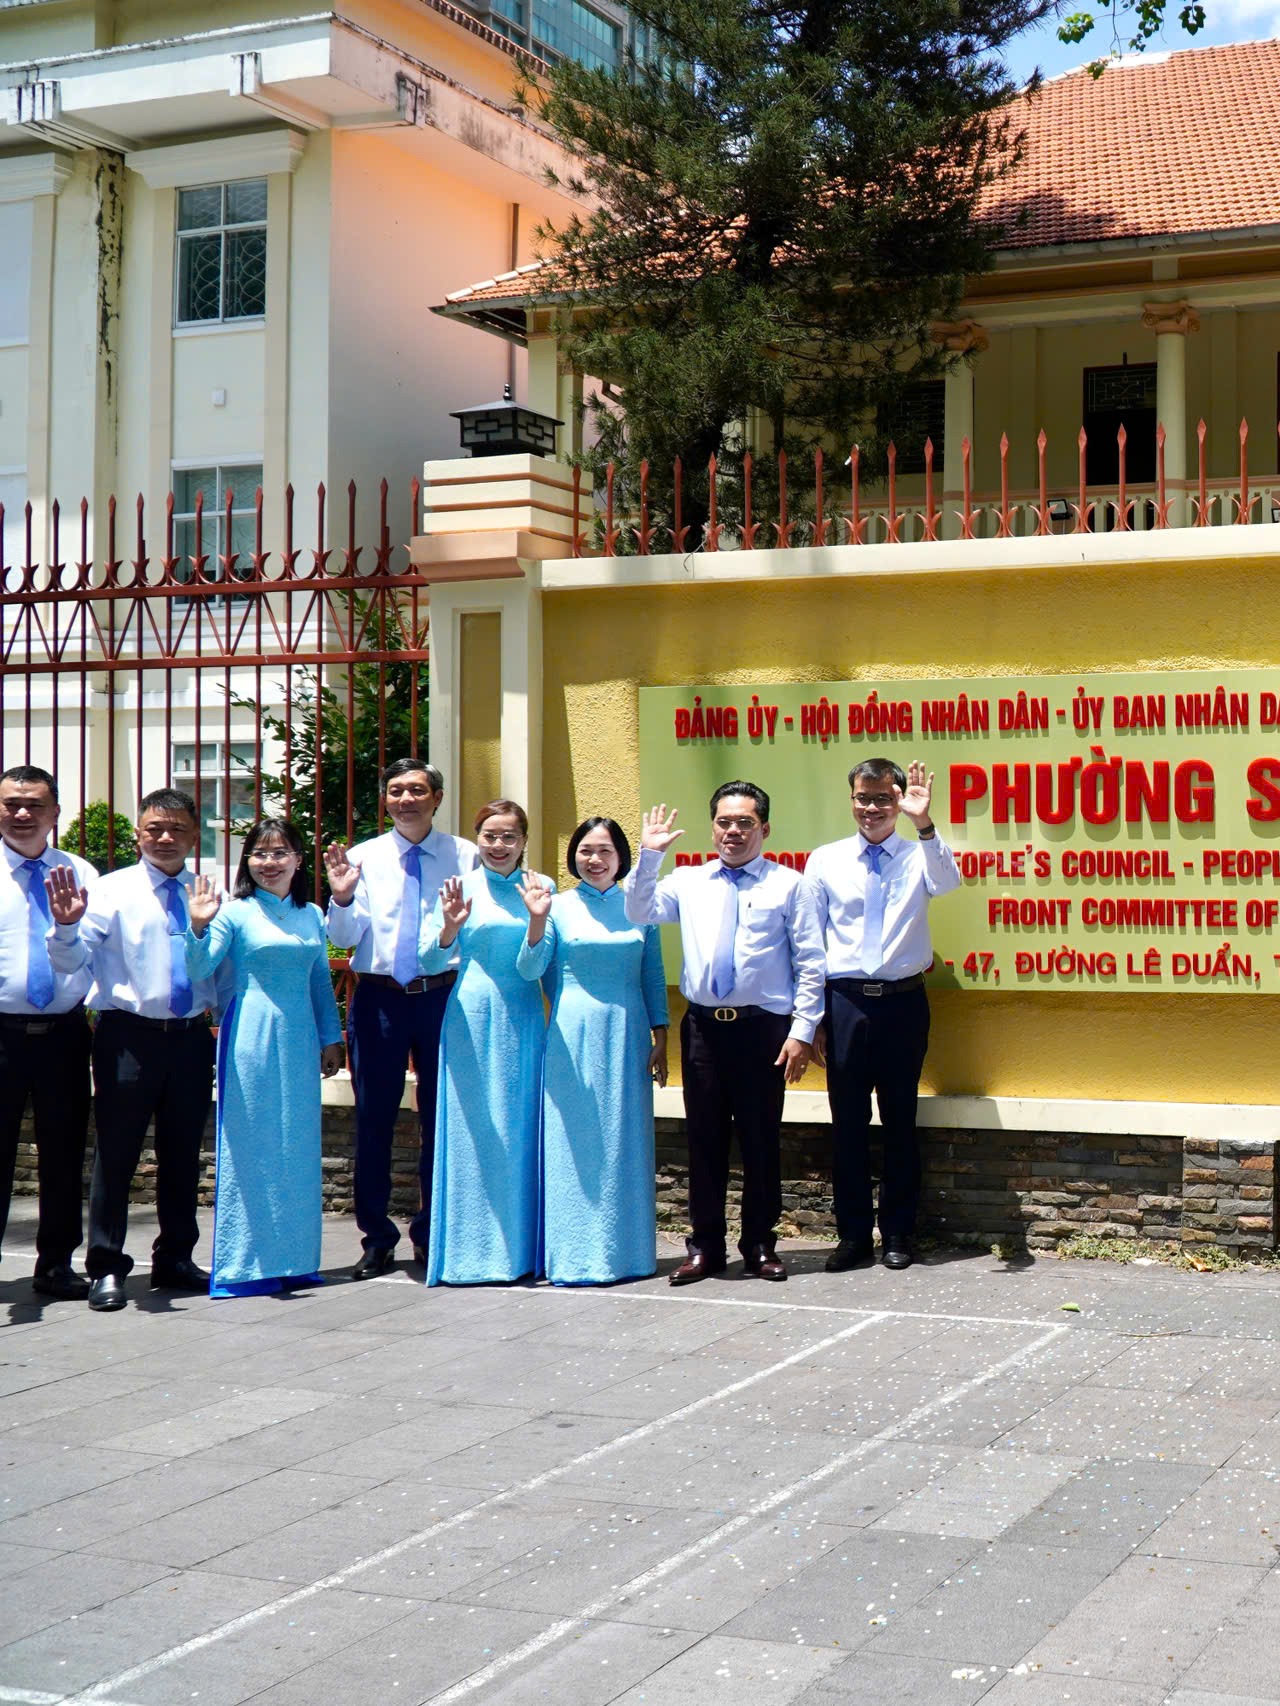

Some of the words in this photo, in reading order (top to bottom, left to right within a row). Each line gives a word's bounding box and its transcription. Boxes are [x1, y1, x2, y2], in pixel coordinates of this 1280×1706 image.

[674, 695, 739, 739] ĐẢNG
[747, 694, 779, 738] ỦY
[800, 696, 840, 743] HỘI
[921, 693, 989, 733] NHÂN
[998, 689, 1049, 731] DÂN
[1072, 685, 1105, 730] ỦY
[1113, 694, 1166, 730] BAN
[1174, 685, 1249, 728] NHÂN
[949, 745, 1215, 826] PHƯỜNG
[1061, 849, 1176, 879] COUNCIL
[988, 897, 1072, 927] FRONT
[1081, 897, 1238, 928] COMMITTEE
[1245, 899, 1279, 928] OF
[962, 951, 1000, 979] 47,
[1014, 944, 1117, 976] ĐƯỜNG
[1126, 946, 1162, 977] LÊ
[1171, 942, 1261, 982] DUẨN,
